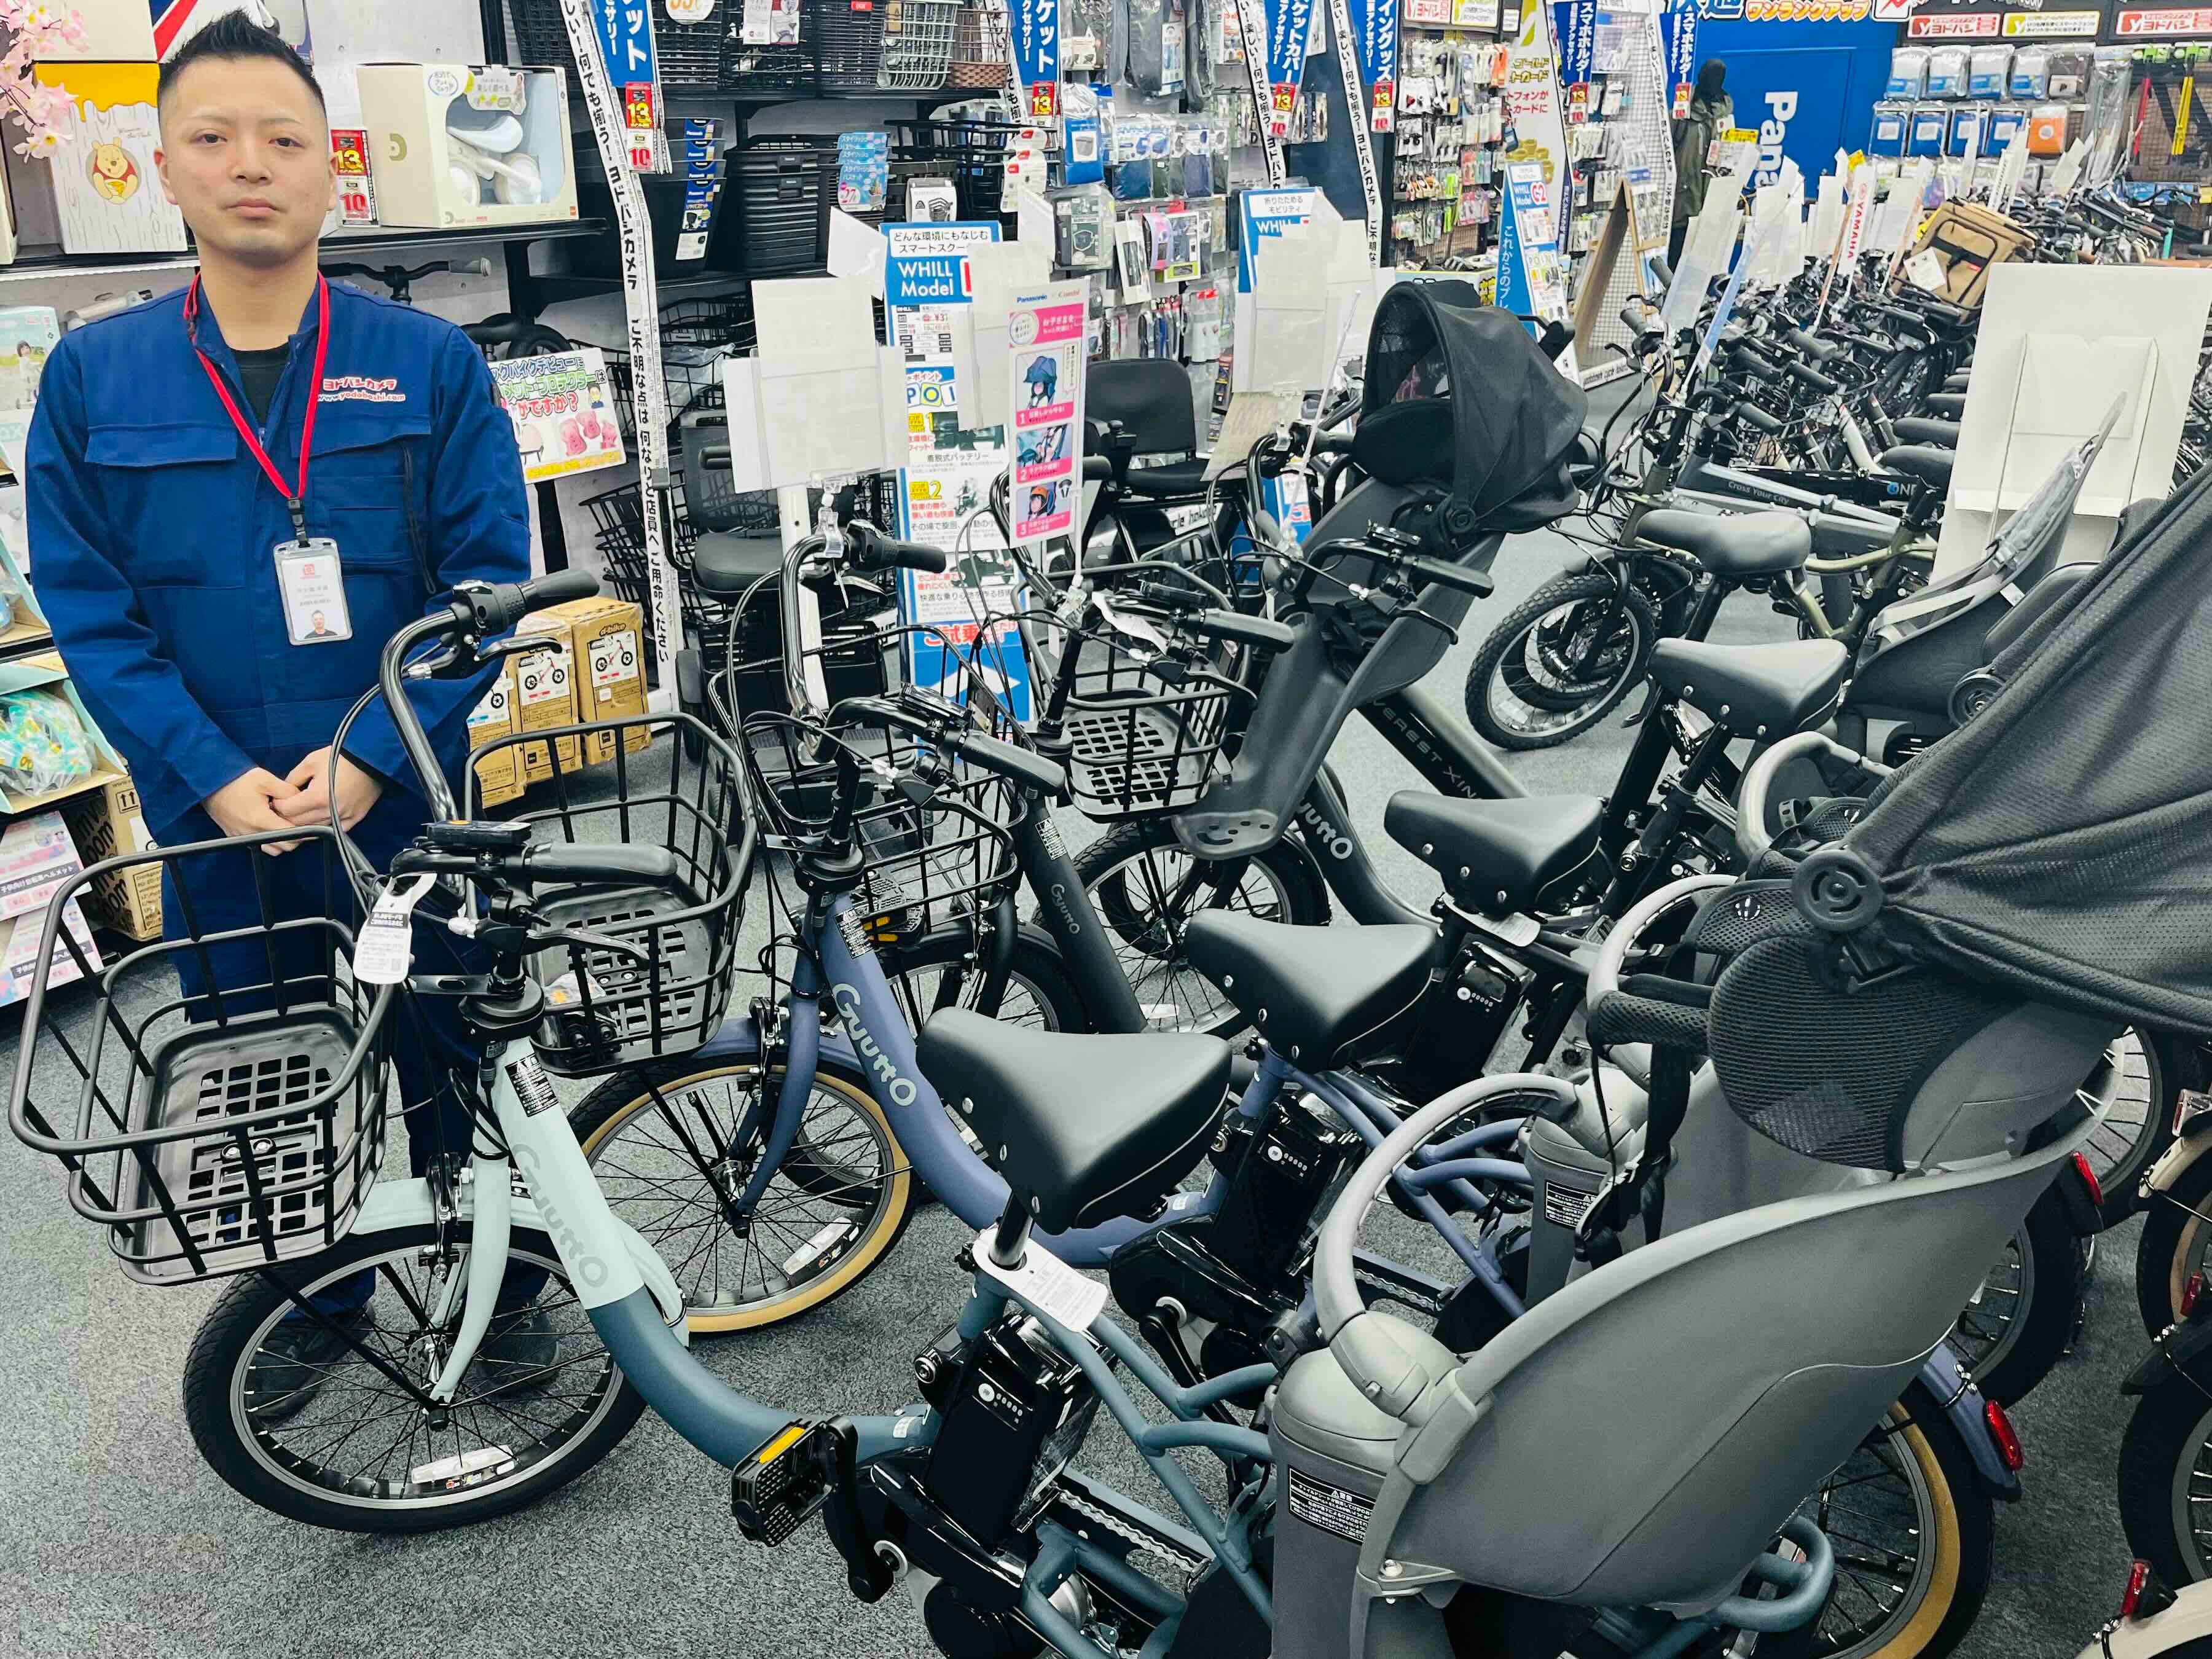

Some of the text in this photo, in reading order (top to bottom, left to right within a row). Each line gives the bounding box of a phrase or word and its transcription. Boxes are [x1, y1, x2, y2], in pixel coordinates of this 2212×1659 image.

[622, 0, 646, 71] ット
[1281, 0, 1309, 83] ケットカバー
[1575, 2, 1594, 82] スマホホルダー
[1679, 12, 1695, 83] スマホホルダー
[1357, 134, 1376, 205] ヨドバシカメラ
[608, 165, 637, 290] ヨドバシカメラ
[894, 231, 988, 241] どんな環境にもなじむ
[899, 244, 970, 253] スマートスクー
[1255, 219, 1291, 233] WHI
[1847, 200, 1868, 260] YAMAHA
[897, 261, 954, 278] WHILL
[900, 278, 954, 297] Model
[323, 377, 397, 391] ヨドバシカメラ
[927, 452, 989, 463] 着脱式バッテリー
[630, 319, 670, 664] ご不明な点は 何なりと店員へ ご用命ください
